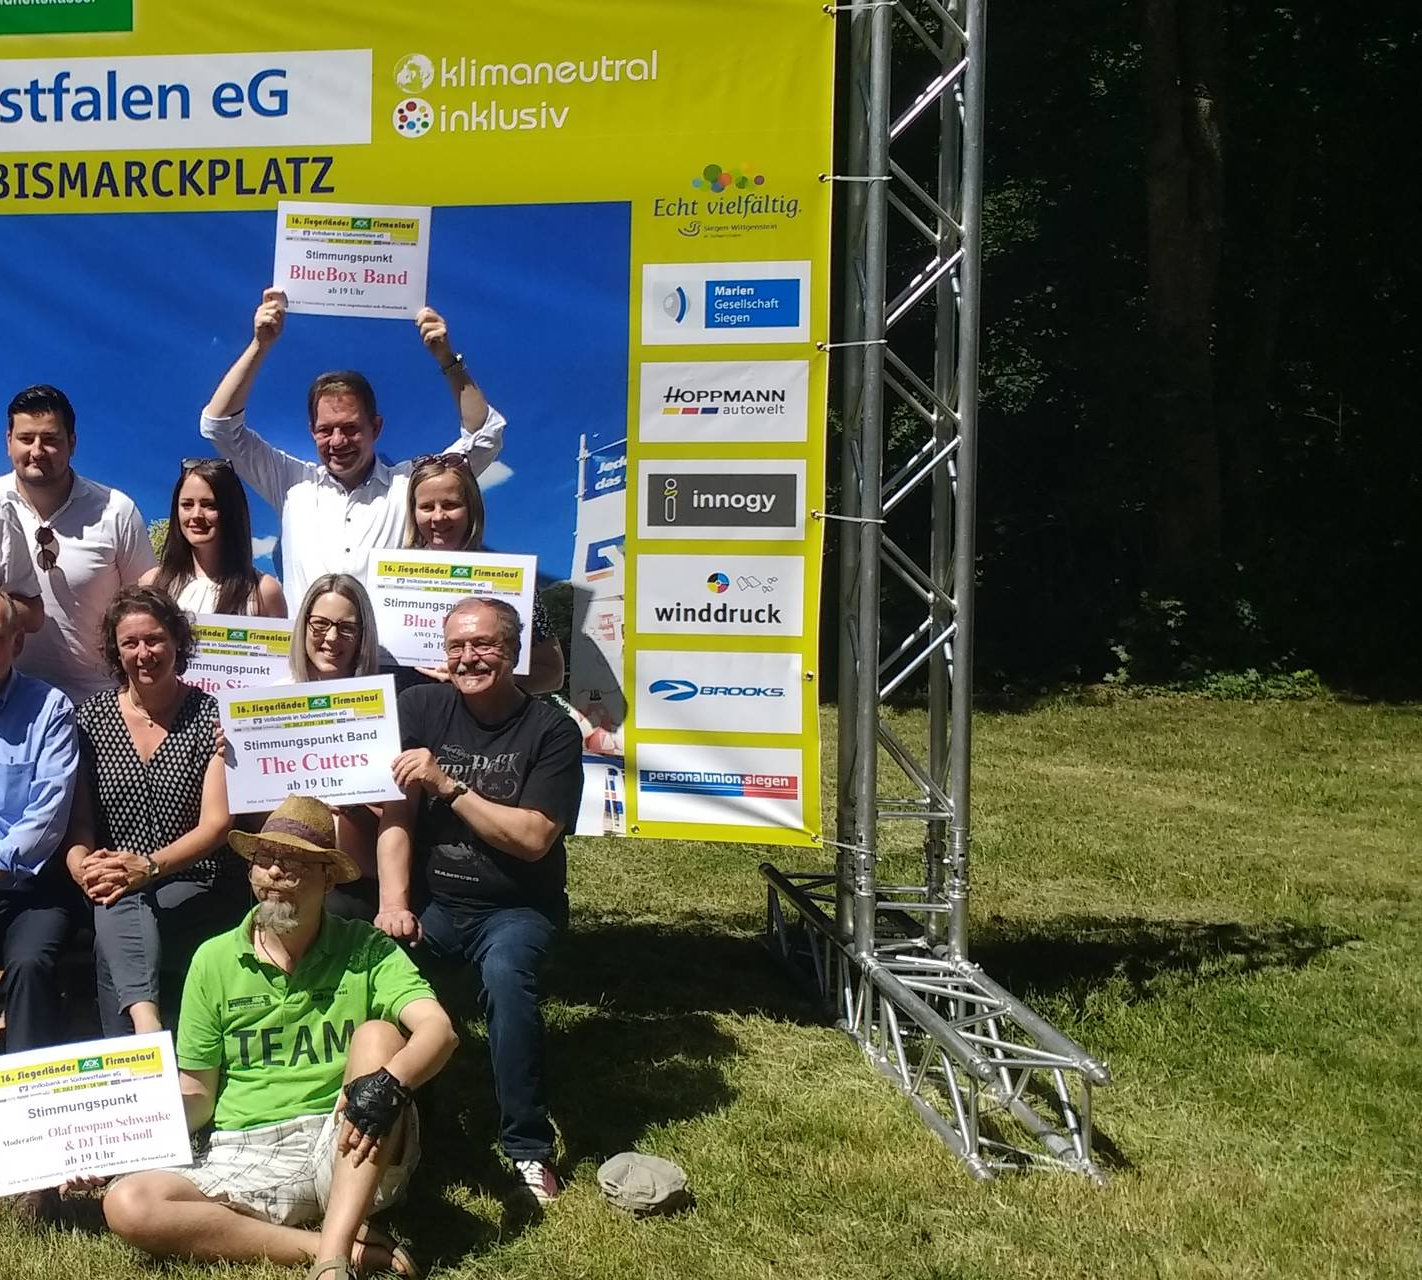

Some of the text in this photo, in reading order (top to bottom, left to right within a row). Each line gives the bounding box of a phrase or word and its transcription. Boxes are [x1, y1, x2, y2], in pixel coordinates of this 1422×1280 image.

[441, 50, 658, 87] klimaneutral
[212, 69, 289, 118] eG
[440, 101, 570, 132] inklusiv
[654, 194, 802, 219] Echt vielfältig.
[304, 217, 349, 228] Siegerländer
[373, 221, 415, 230] Firmenlauf
[306, 250, 393, 264] Stimmungspunkt
[290, 265, 408, 285] BlueBox Band
[350, 287, 364, 295] Uhr
[714, 286, 755, 296] Marien
[714, 299, 779, 310] Gesellschaft
[714, 313, 750, 325] Siegen
[663, 386, 785, 403] HOPPMANN
[723, 404, 785, 415] autowelt
[595, 475, 621, 490] das
[693, 490, 776, 513] innogy
[398, 565, 448, 575] Siegerländer
[474, 569, 518, 579] Firmenlauf
[403, 614, 436, 628] Blue
[655, 602, 781, 624] winddruck
[423, 641, 434, 649] ab
[252, 702, 306, 713] Siegerländer
[333, 694, 379, 704] Firmenlauf
[243, 730, 378, 751] Stimmungspunkt Band
[257, 752, 369, 775] The Cuters
[286, 777, 343, 791] ab 19 Uhr
[648, 771, 789, 788] personalunion.siegen
[231, 1019, 355, 1070] TEAM
[1, 1052, 155, 1083] 16. Siegerländer Firmenlauf
[28, 1092, 138, 1119] Stimmungspunkt
[2, 1111, 171, 1147] Moderation Olaf neopan Schwanke
[64, 1129, 153, 1151] & DJ Tim Knoll
[64, 1155, 77, 1166] ab
[81, 1152, 92, 1163] 19
[95, 1149, 115, 1161] Uhr
